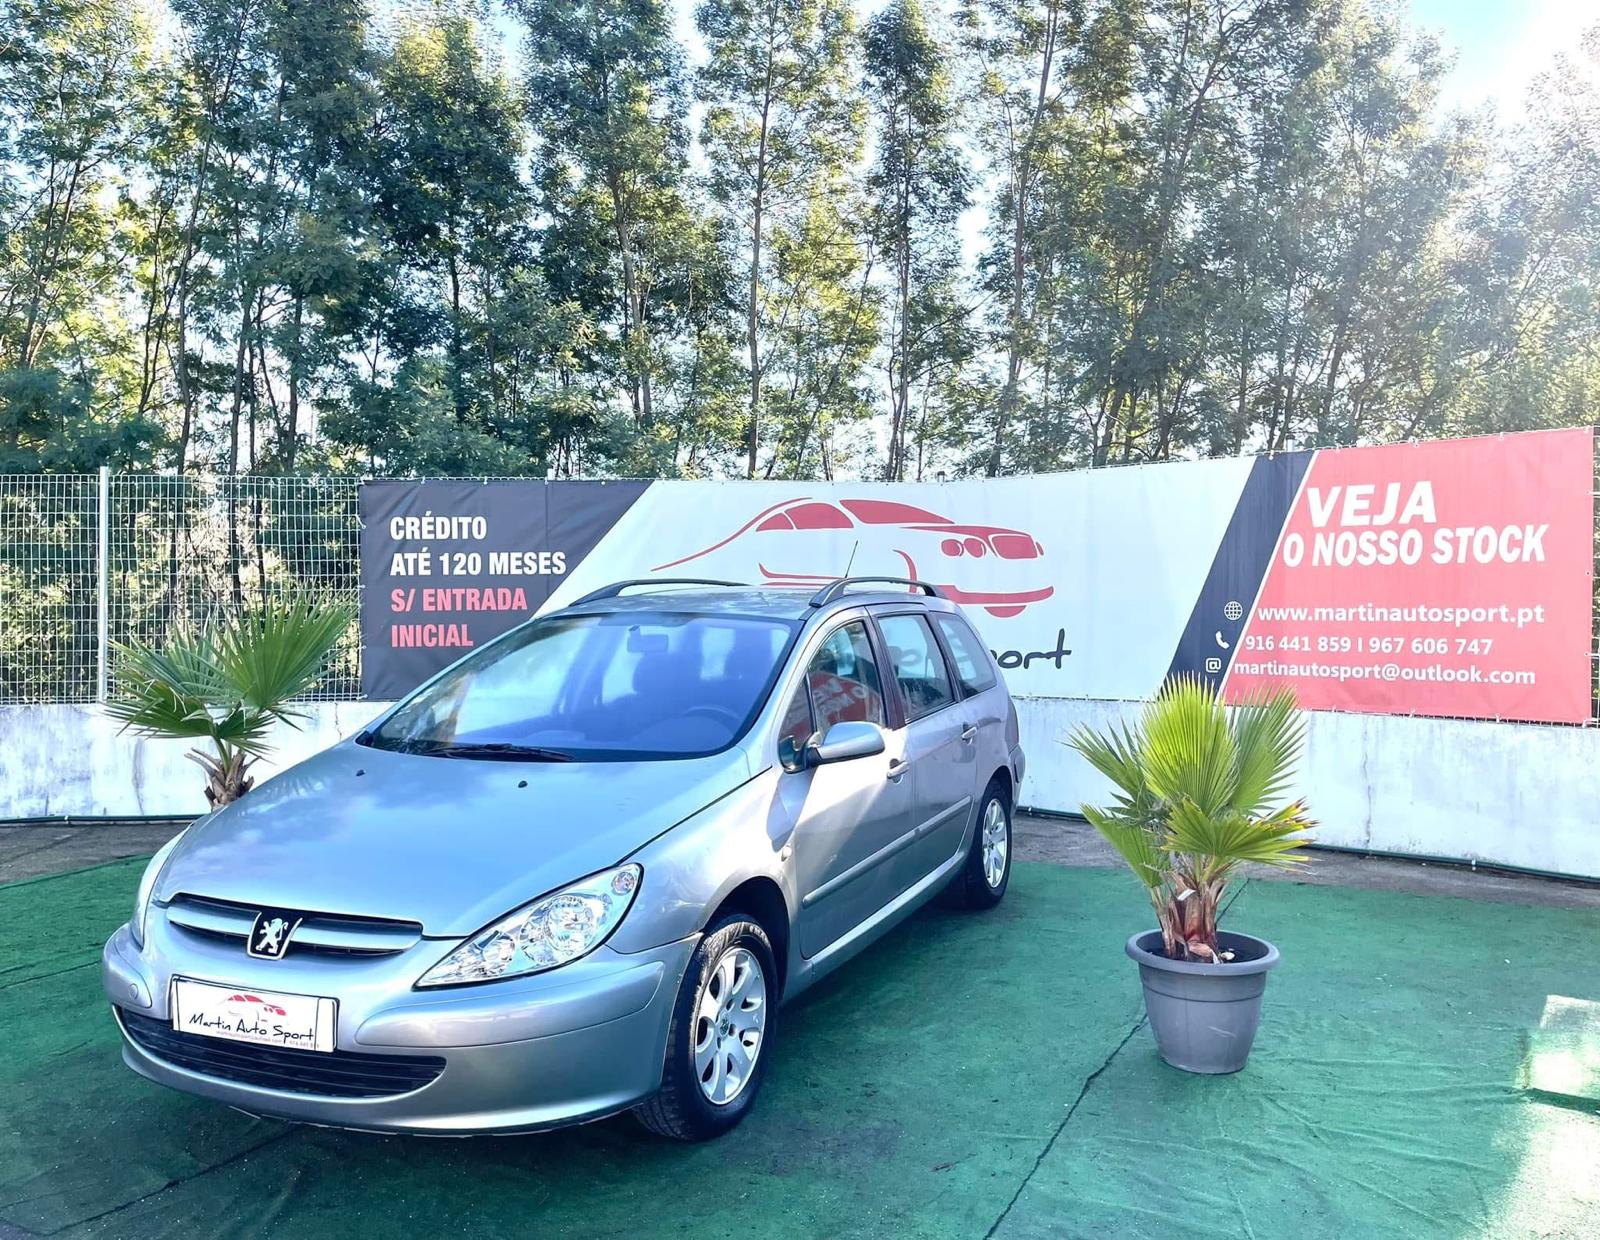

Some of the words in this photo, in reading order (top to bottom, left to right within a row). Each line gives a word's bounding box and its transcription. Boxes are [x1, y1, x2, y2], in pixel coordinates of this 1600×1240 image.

[1306, 480, 1438, 528] VEJA
[390, 511, 487, 540] CRÉDITO
[1282, 532, 1305, 568] O
[1311, 529, 1424, 568] NOSSO
[1431, 523, 1550, 565] STOCK
[390, 547, 432, 576] ATÉ
[439, 552, 482, 576] 120
[489, 552, 567, 575] MESES
[391, 588, 416, 612] S/
[422, 588, 528, 612] ENTRADA
[1258, 603, 1545, 628] www.martinautosport.pt
[391, 624, 474, 648] INICIAL
[989, 628, 1072, 669] ort
[1245, 635, 1274, 651] 916
[1279, 636, 1311, 652] 441
[1318, 636, 1352, 653] 859
[1369, 637, 1405, 654] 967
[1411, 638, 1449, 655] 606
[1455, 639, 1494, 656] 747
[1234, 660, 1536, 685] martinautosport@outlook.com
[189, 1012, 231, 1031] Martin
[236, 1019, 267, 1036] Auto
[273, 1025, 314, 1044] Sport
